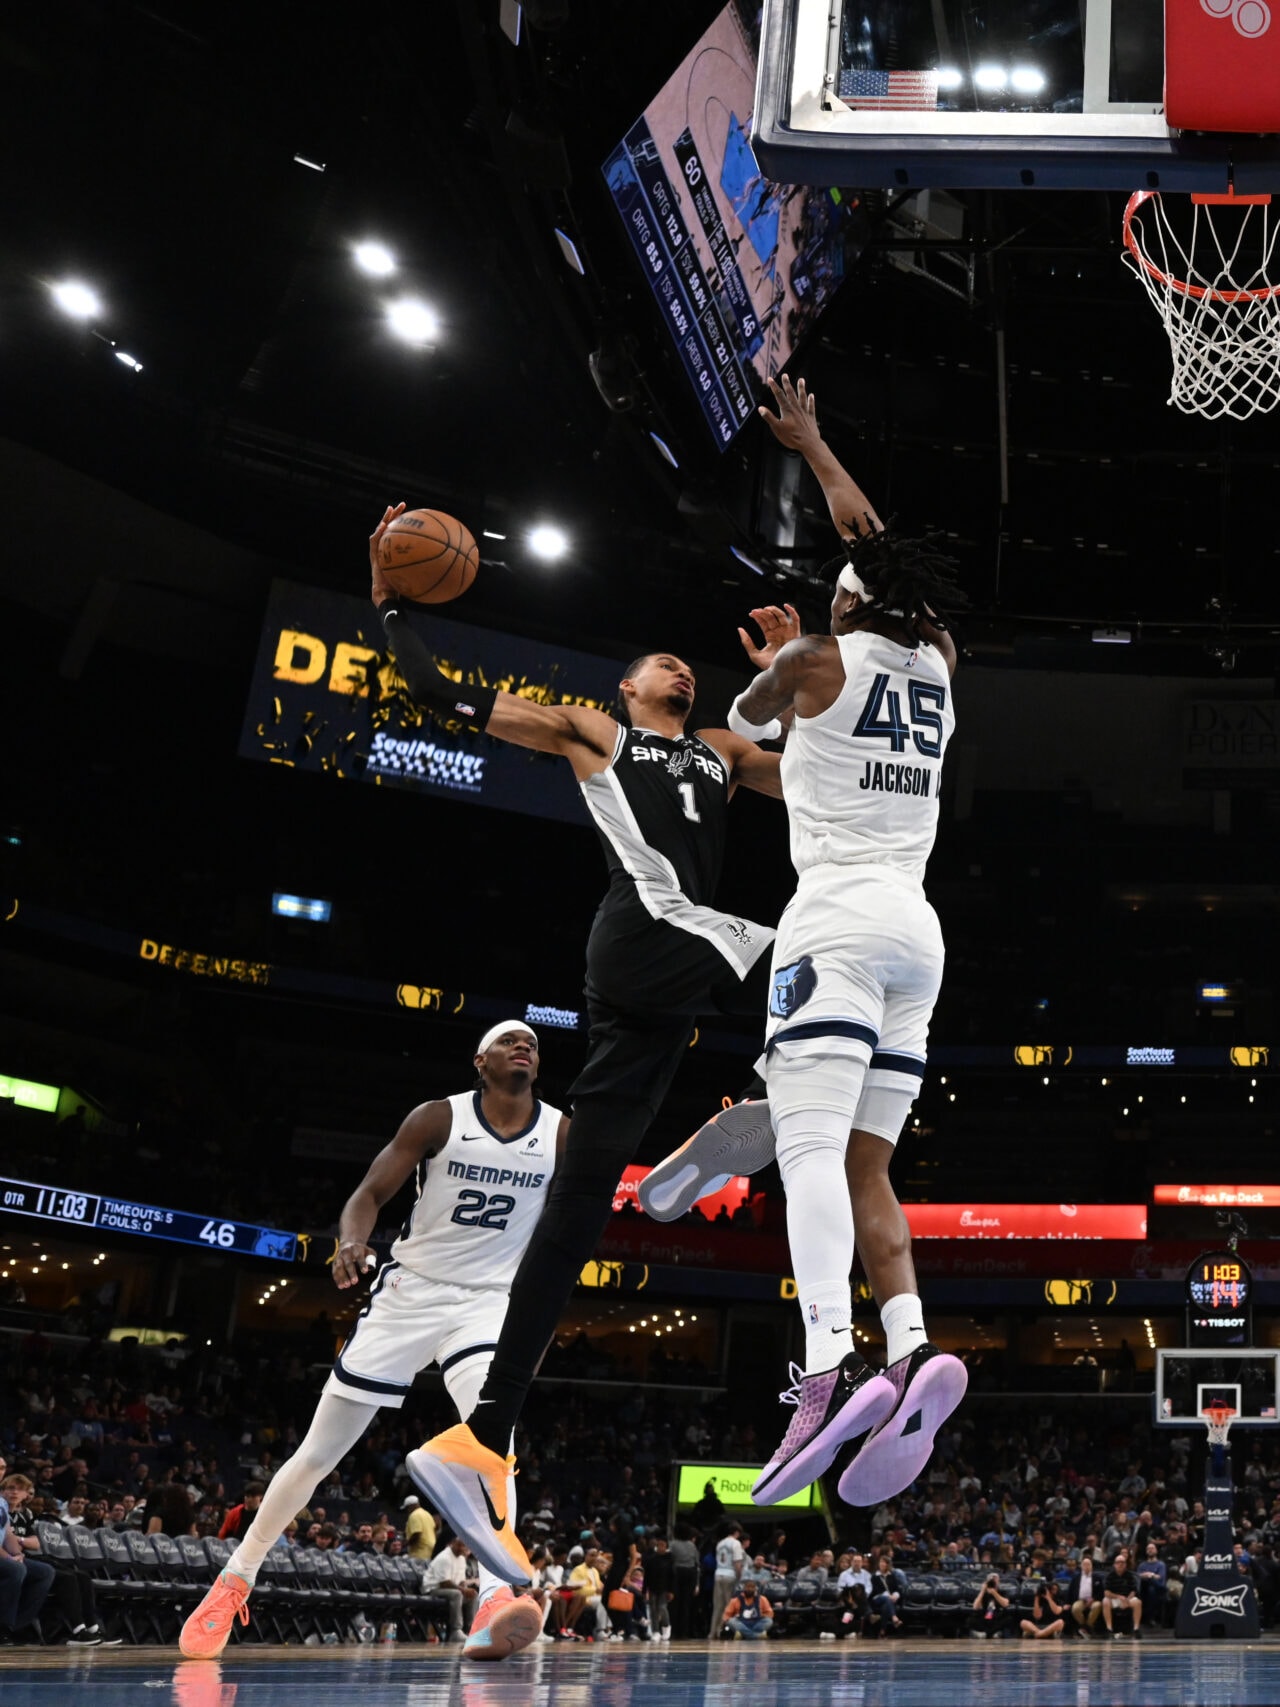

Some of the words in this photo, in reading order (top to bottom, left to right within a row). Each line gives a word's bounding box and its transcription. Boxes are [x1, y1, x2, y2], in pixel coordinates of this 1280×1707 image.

[685, 156, 701, 186] 60
[652, 181, 671, 216] ORTG
[666, 214, 683, 246] 112.9
[680, 249, 694, 275] TS%
[688, 273, 707, 310] 59.8%
[716, 343, 729, 366] 22.7
[632, 208, 650, 243] ORTG
[646, 242, 663, 273] 85.9
[660, 274, 674, 301] TS%
[669, 298, 688, 336] 50.5%
[699, 370, 711, 391] 0.0
[719, 418, 732, 442] 14.9
[742, 314, 756, 337] 46
[852, 673, 945, 760] 45
[371, 732, 484, 771] SealMaster
[631, 746, 723, 784] SPURS
[859, 761, 931, 797] JACKSON
[678, 782, 701, 823] 1
[526, 1003, 579, 1019] SealMaster
[1127, 1047, 1174, 1056] SealMaster
[447, 1160, 546, 1188] MEMPHIS
[5, 1190, 25, 1207] QTR
[36, 1189, 88, 1221] 11:03
[104, 1202, 165, 1223] TIMEOUTS:
[166, 1213, 173, 1223] 5
[450, 1189, 516, 1231] 22
[101, 1214, 141, 1231] FOULS:
[143, 1222, 152, 1232] 0
[199, 1220, 236, 1247] 46
[1204, 1264, 1240, 1280] 11:03
[1213, 1280, 1238, 1308] 14
[1207, 1318, 1246, 1327] TISSOT
[1204, 1554, 1232, 1562] KIA
[1199, 1595, 1240, 1607] SONIC
